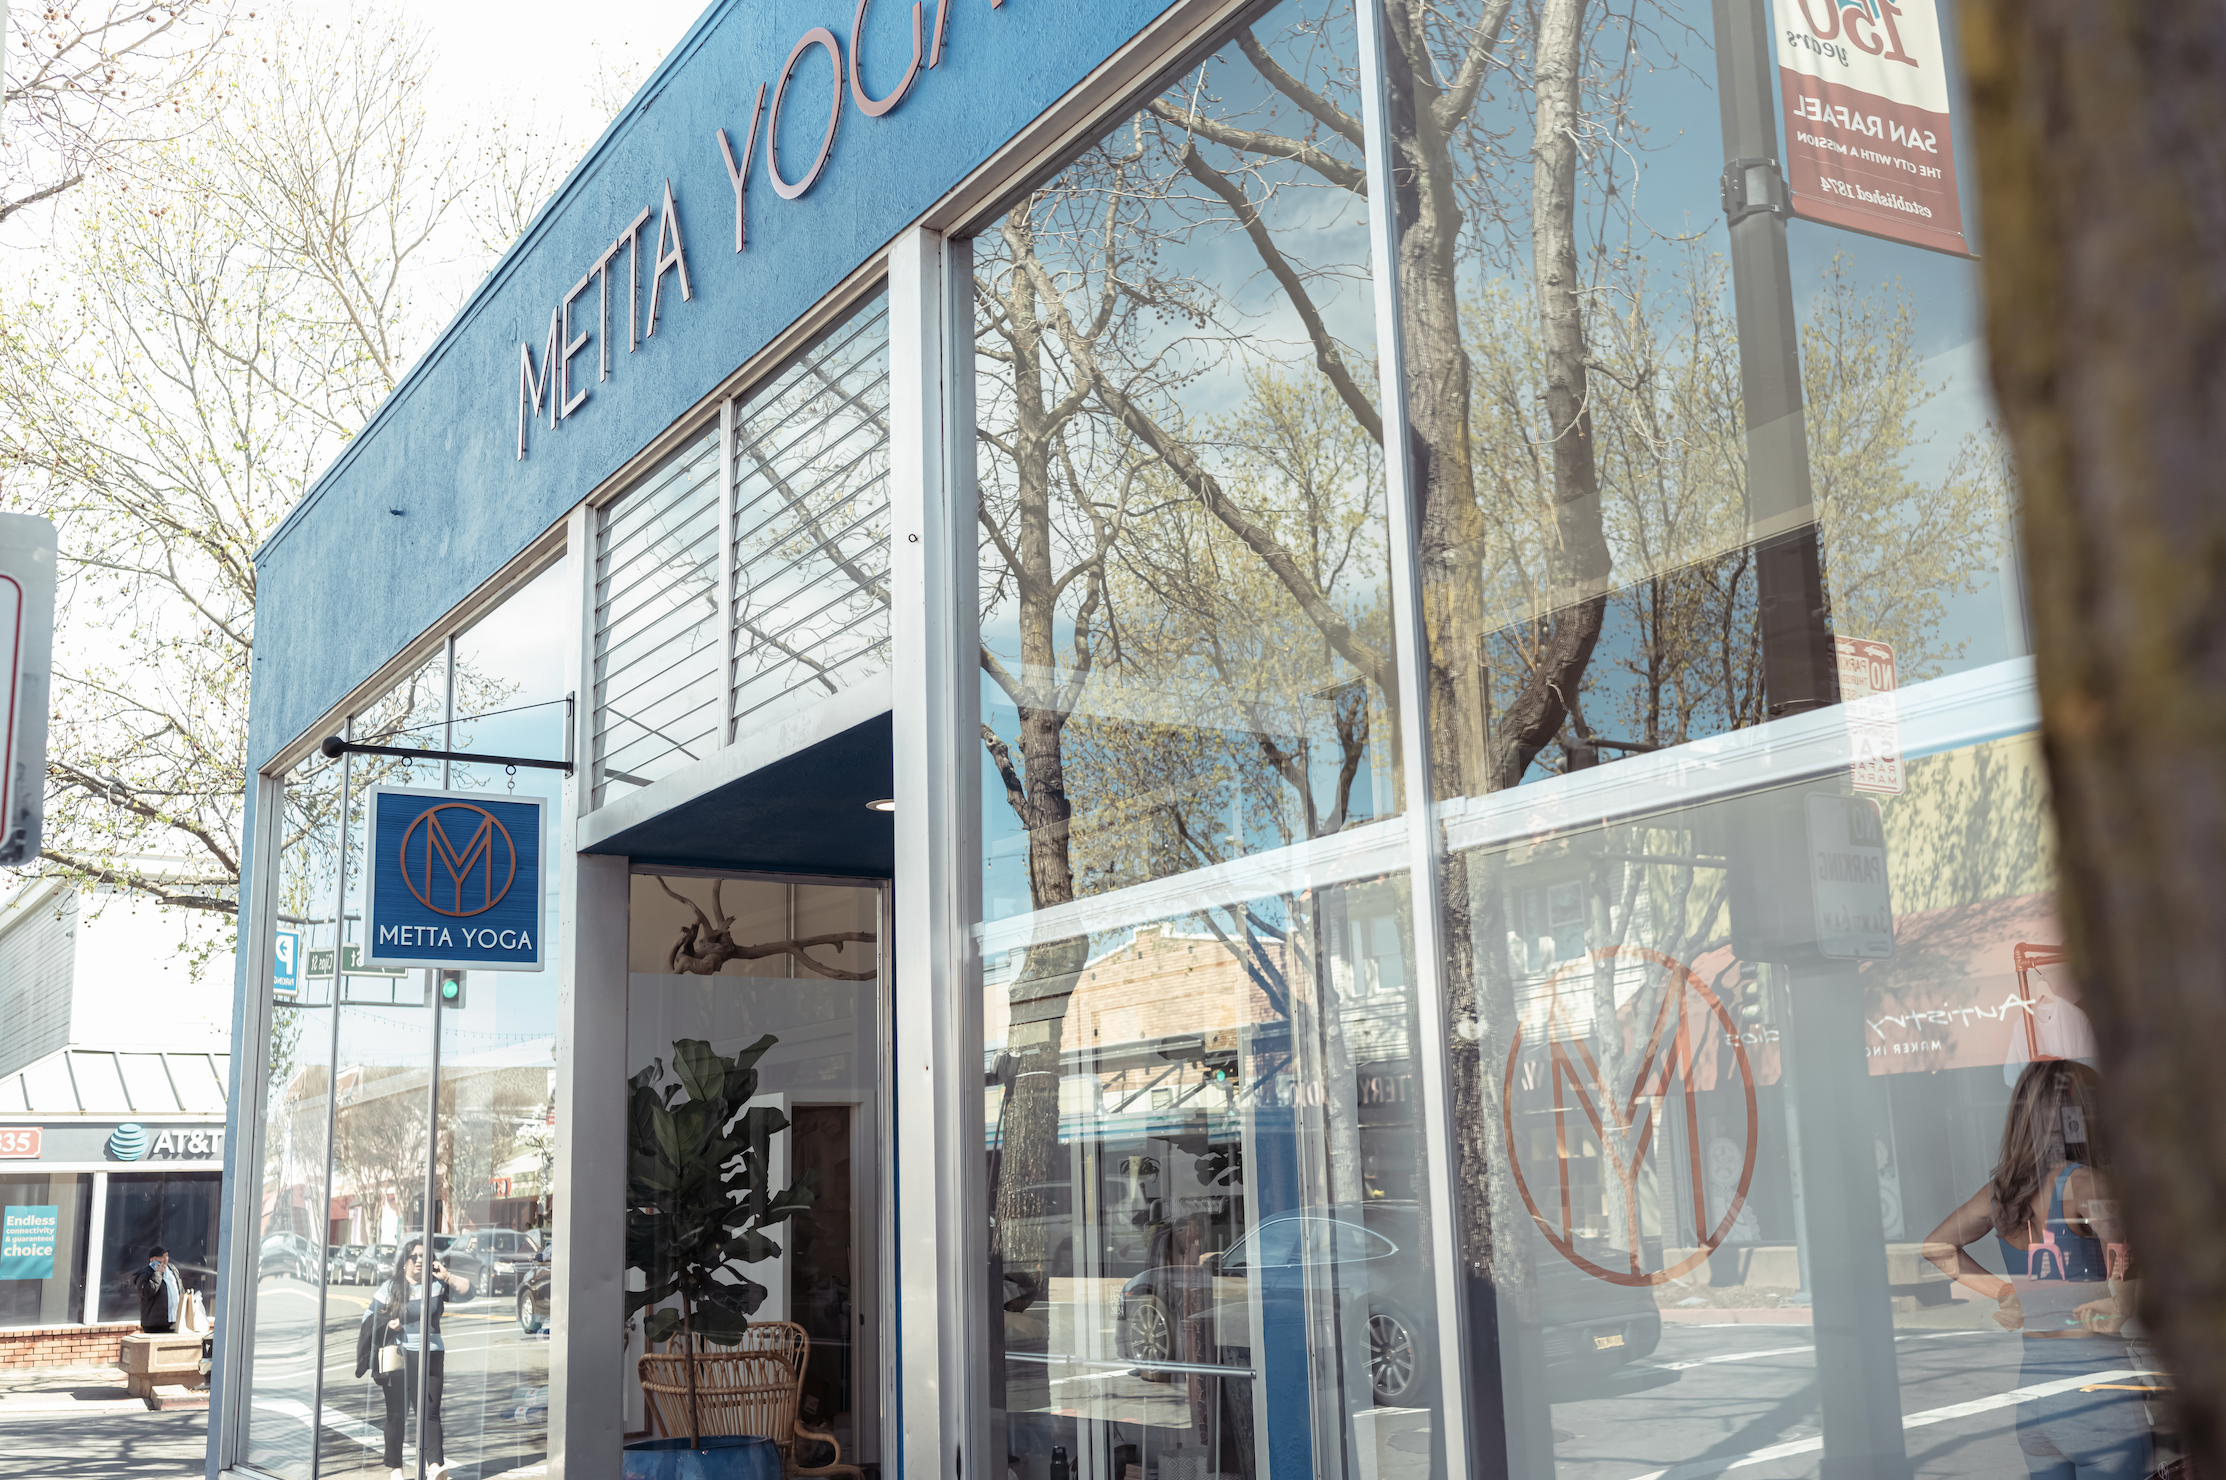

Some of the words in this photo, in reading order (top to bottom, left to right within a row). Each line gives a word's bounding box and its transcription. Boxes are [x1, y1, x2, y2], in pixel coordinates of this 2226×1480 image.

[518, 177, 692, 462] METTA
[716, 0, 1003, 254] YOG
[379, 924, 453, 948] METTA
[462, 927, 533, 951] YOGA
[153, 1129, 225, 1153] AT&T
[7, 1215, 55, 1226] Endless
[6, 1227, 54, 1235] connectivity
[12, 1235, 54, 1243] guaranteed
[4, 1243, 53, 1257] choice
